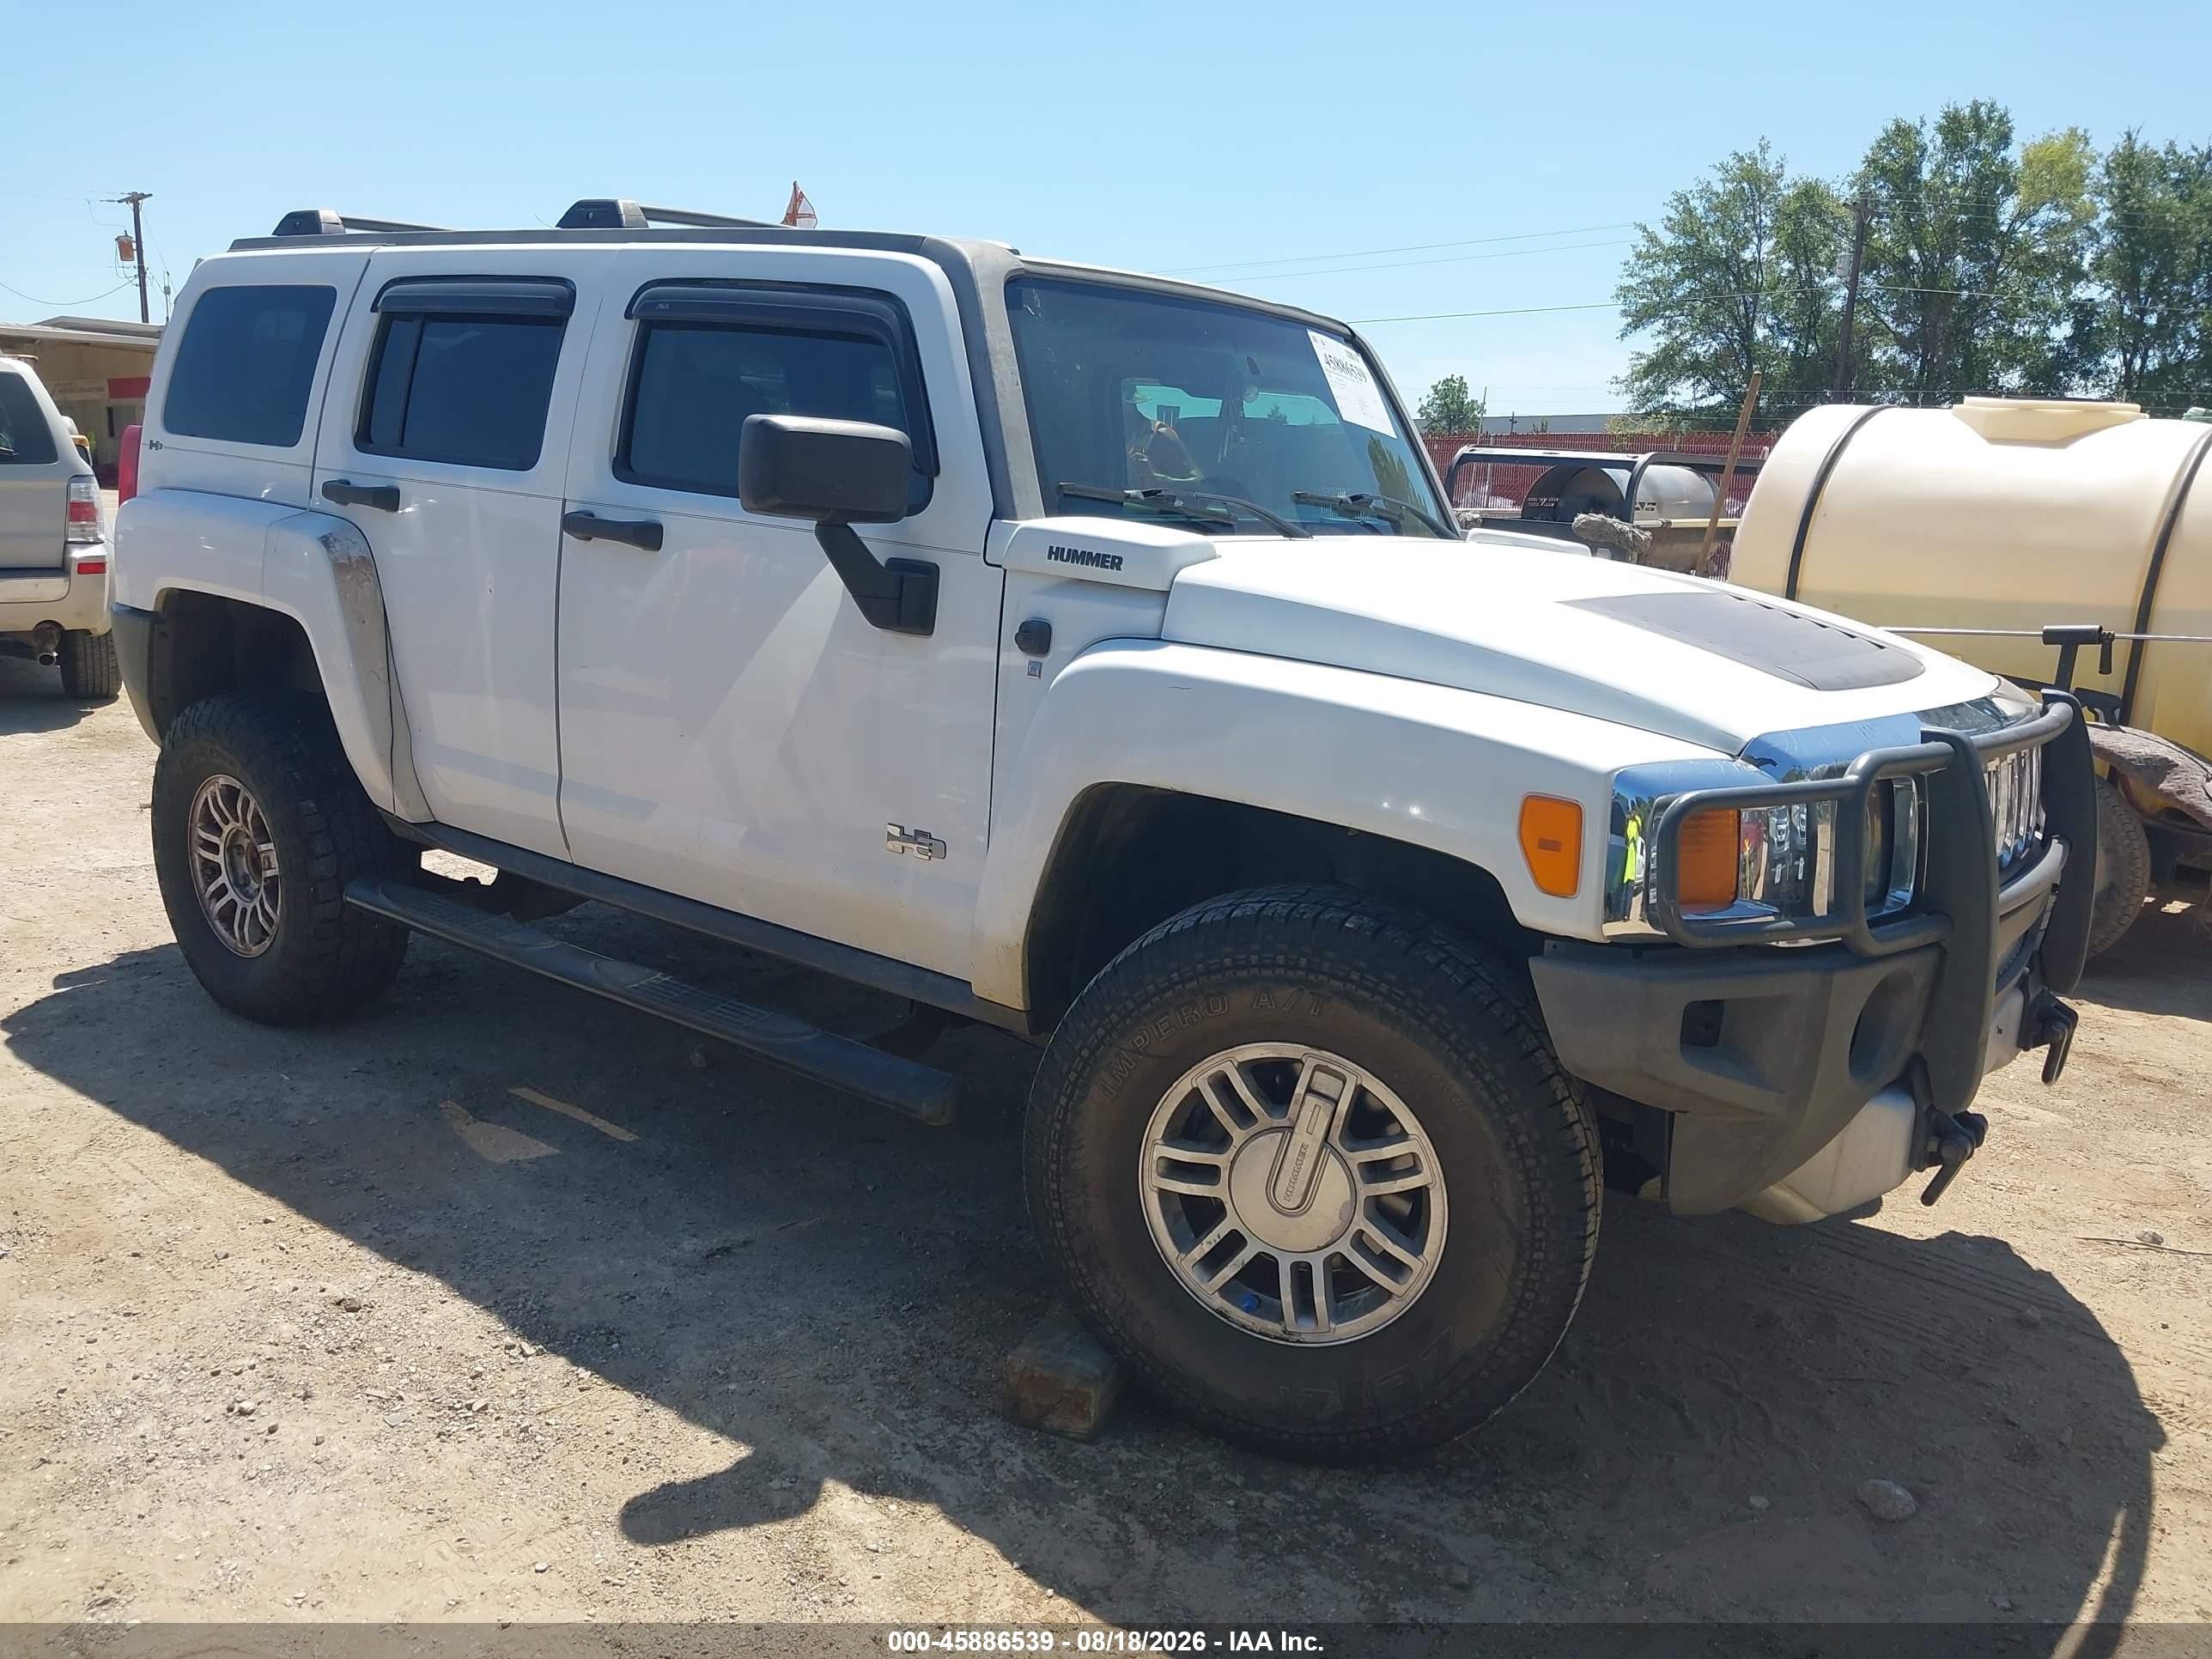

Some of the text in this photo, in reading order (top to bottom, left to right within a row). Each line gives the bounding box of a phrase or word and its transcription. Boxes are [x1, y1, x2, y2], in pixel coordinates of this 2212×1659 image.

[1323, 352, 1367, 383] 45886539
[1047, 545, 1124, 572] HUMMER
[1097, 988, 1331, 1098] IMPERO A/T
